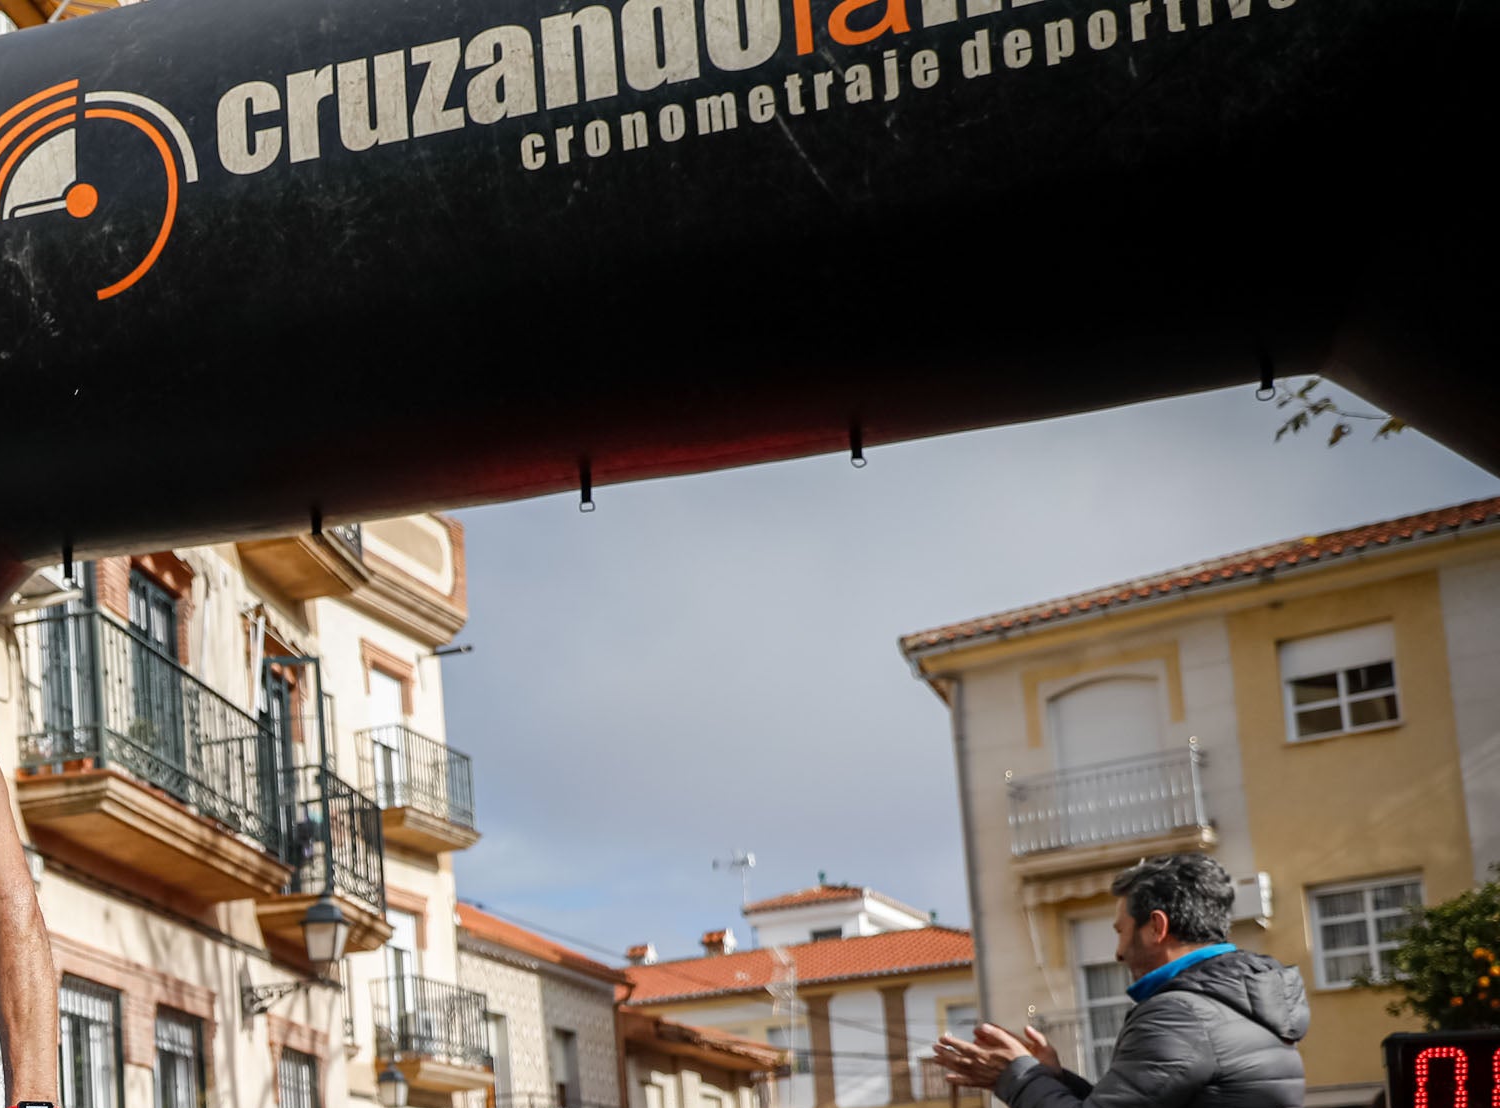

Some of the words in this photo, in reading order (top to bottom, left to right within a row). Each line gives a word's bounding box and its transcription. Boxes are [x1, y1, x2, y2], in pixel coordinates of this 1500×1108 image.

[216, 0, 1046, 176] cruzandoa
[520, 46, 940, 171] cronometraje
[961, 0, 1298, 80] deport
